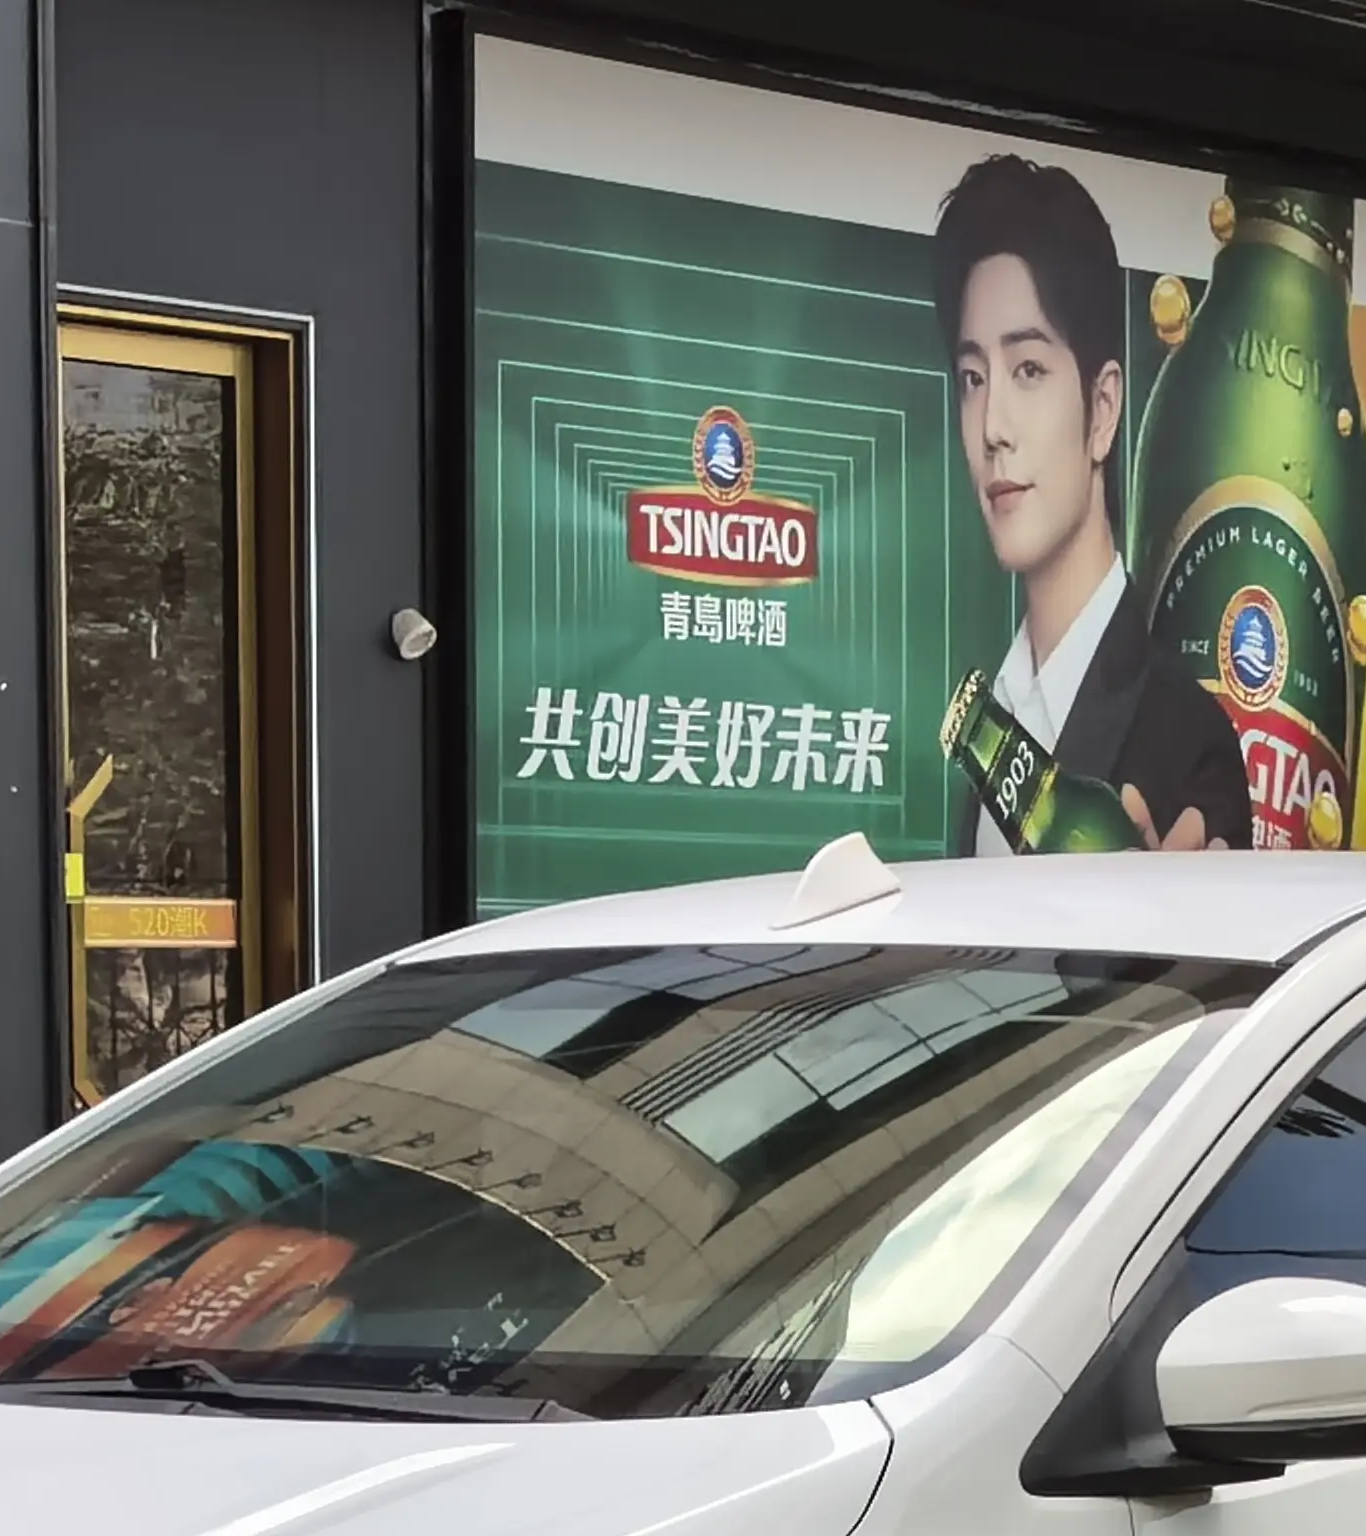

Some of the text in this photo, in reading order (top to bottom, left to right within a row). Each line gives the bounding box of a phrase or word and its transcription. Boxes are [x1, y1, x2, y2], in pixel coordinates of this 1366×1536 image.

[639, 504, 807, 567] TSINGTAO
[1166, 525, 1241, 609] PREMIUM
[1251, 526, 1308, 582] LAGER
[516, 687, 892, 792] 共创美好未来
[995, 740, 1035, 820] 1903
